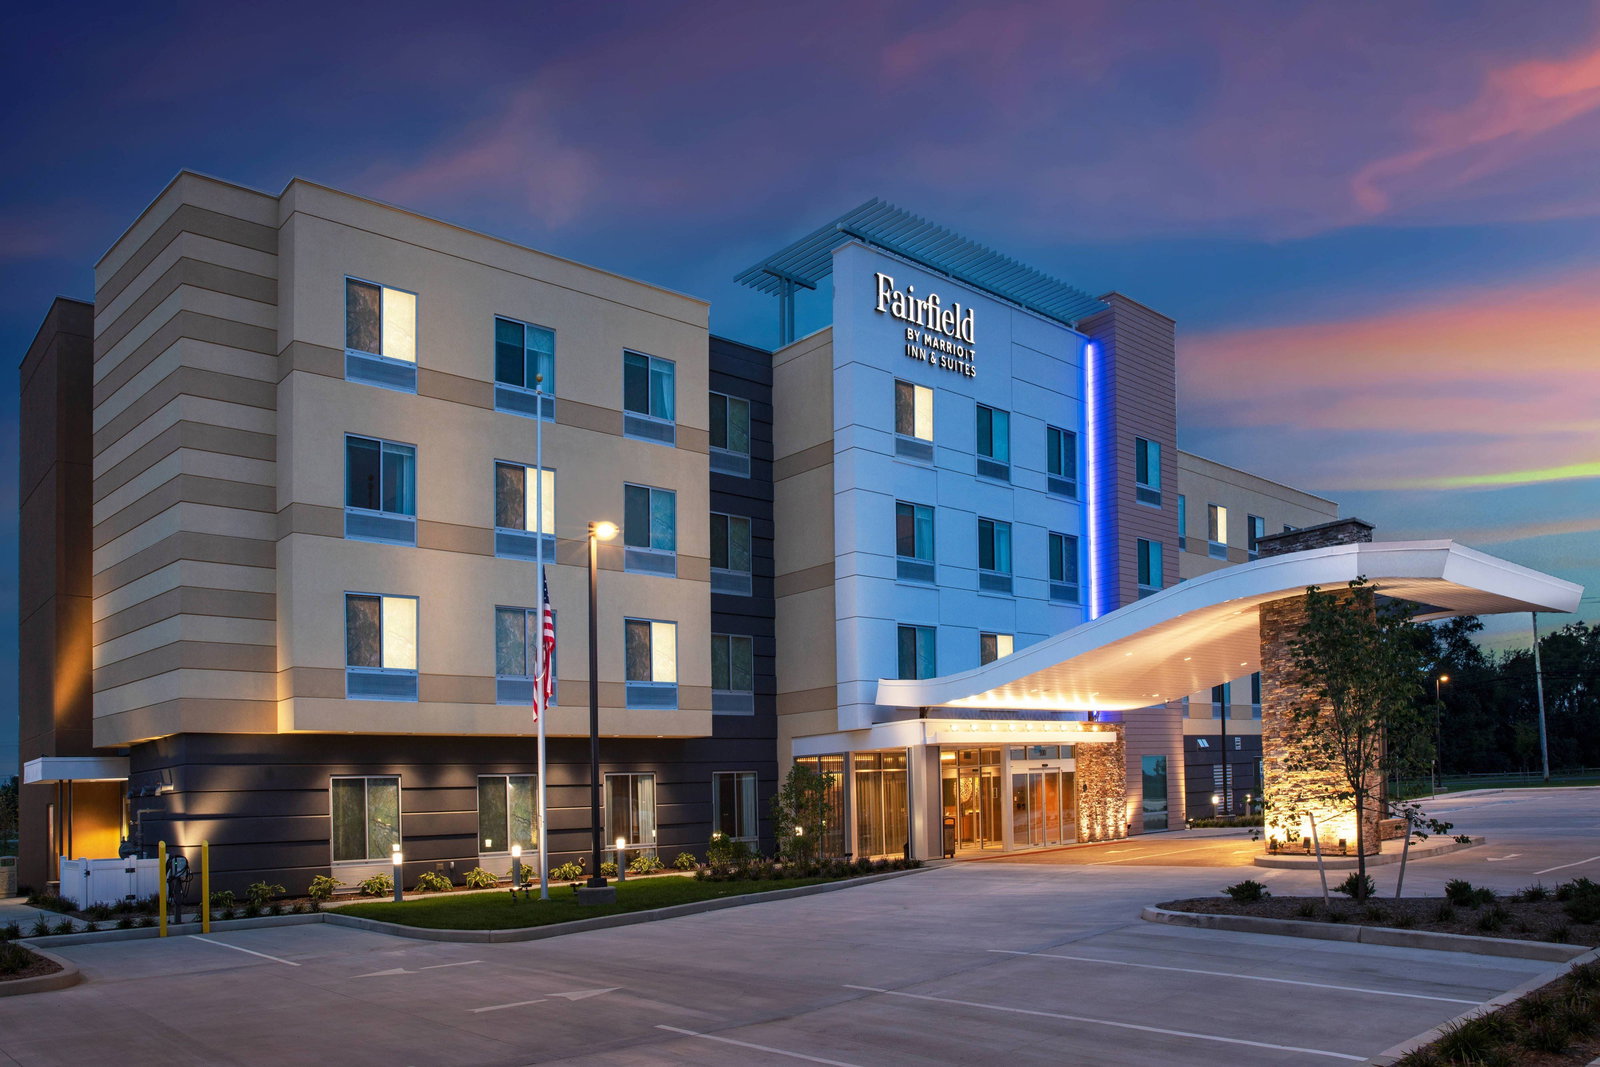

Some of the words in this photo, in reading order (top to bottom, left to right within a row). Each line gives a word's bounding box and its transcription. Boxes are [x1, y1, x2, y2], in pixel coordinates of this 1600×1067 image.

[876, 272, 975, 345] Fairfield
[906, 327, 920, 342] BY
[923, 333, 976, 361] MARRIOTT
[906, 343, 926, 361] INN
[930, 351, 937, 364] &
[940, 355, 977, 377] SUITES
